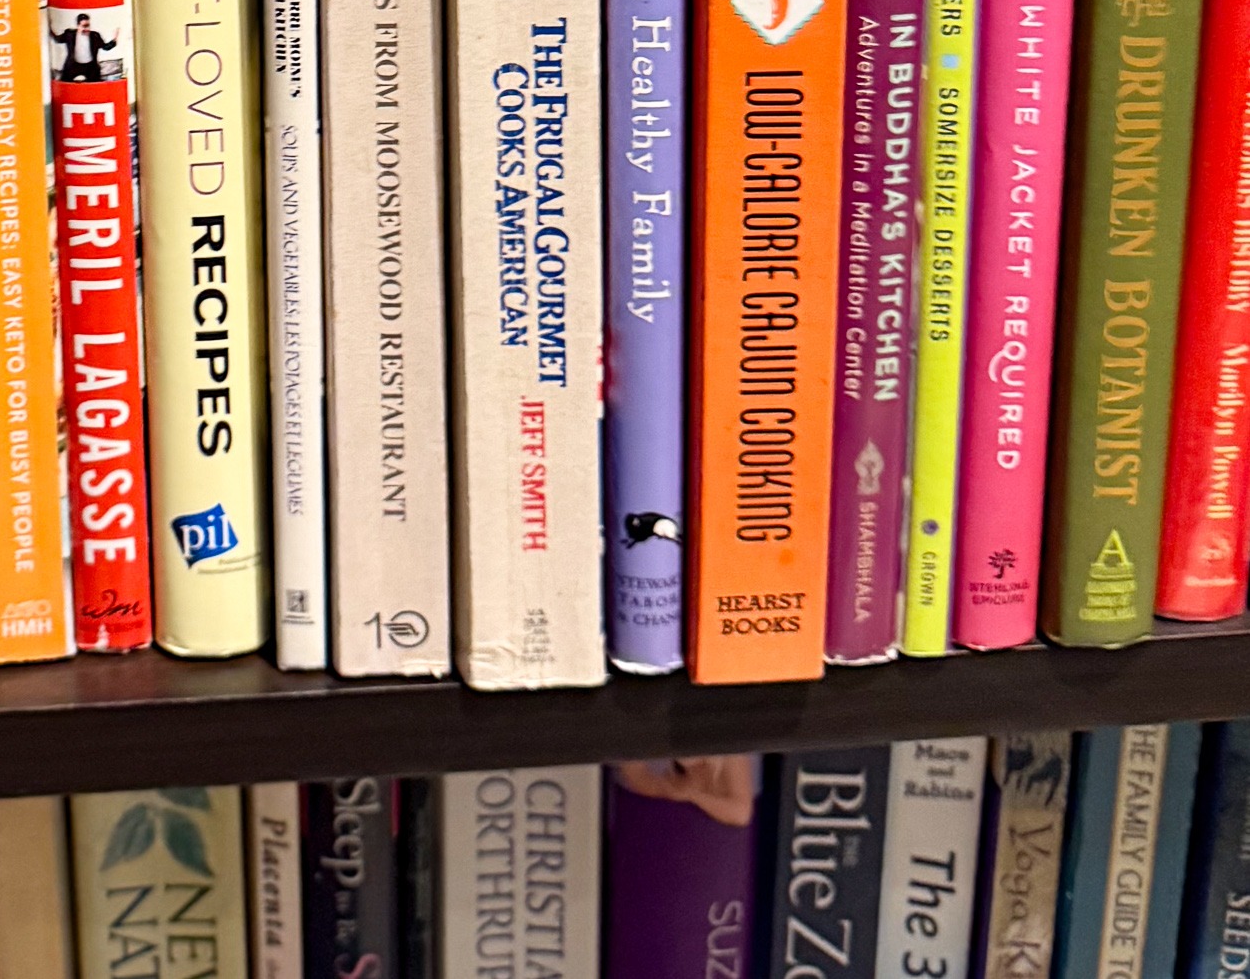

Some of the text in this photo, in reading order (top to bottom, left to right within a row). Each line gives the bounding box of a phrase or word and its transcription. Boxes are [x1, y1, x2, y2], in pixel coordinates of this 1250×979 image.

[274, 7, 288, 73] KITCHEN
[373, 22, 400, 109] FROM
[624, 15, 673, 174] Healthy
[61, 101, 123, 306] EMERIL
[281, 176, 299, 216] AND
[492, 62, 532, 348] COOKS AMERICAN
[530, 16, 570, 389] THE FRUGAL GOURMET
[842, 15, 881, 401] Adventures in a Meditation Center
[872, 13, 918, 402] IN BUDDHA'S KITCHEN
[933, 87, 961, 218] SOMERSIZE
[1107, 34, 1169, 259] DRUNKEN
[1, 258, 23, 309] EASY
[375, 121, 404, 322] MOOSEWOOD
[626, 189, 672, 325] Family
[928, 229, 954, 343] DESSERTS
[989, 6, 1047, 471] WHITE JACKET REQUIRED
[3, 316, 26, 373] KETO
[189, 214, 233, 460] RECIPES
[735, 70, 805, 544] LOW-CALORIE CAJUN COOKING
[5, 380, 29, 424] FOR
[8, 430, 31, 484] BUSY
[72, 332, 136, 567] LAGASSE
[379, 332, 407, 523] RESTAURANT
[1092, 278, 1154, 507] BOTANIST
[1207, 343, 1250, 520] Marilyn Powell
[10, 489, 35, 574] PEOPLE
[179, 513, 234, 559] pil
[520, 395, 548, 552] JEFF SMITH
[716, 592, 806, 613] HEARST
[720, 616, 802, 636] BOOKS
[918, 551, 938, 607] CROWN
[319, 777, 382, 889] Sleep
[788, 767, 872, 910] Blue
[904, 849, 957, 939] The
[1000, 823, 1054, 922] Yoga
[1110, 770, 1155, 950] FAMILY GUIDE
